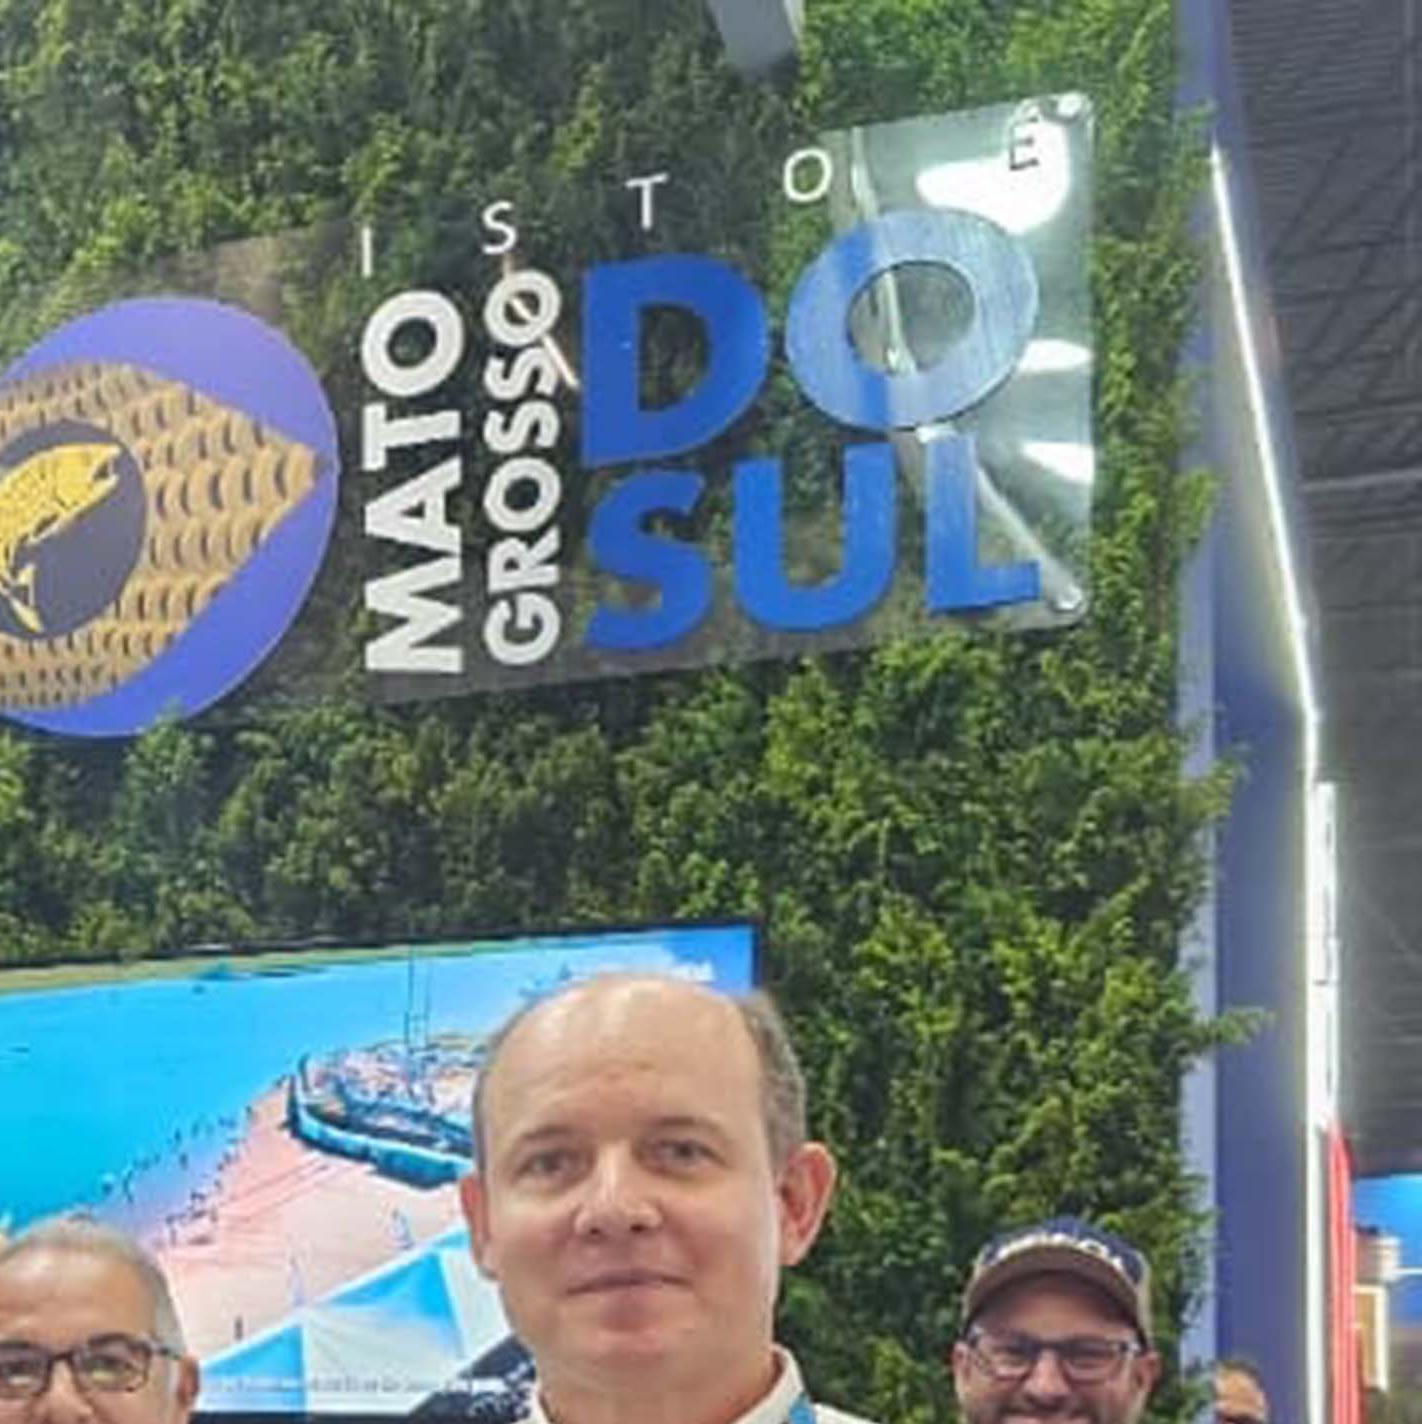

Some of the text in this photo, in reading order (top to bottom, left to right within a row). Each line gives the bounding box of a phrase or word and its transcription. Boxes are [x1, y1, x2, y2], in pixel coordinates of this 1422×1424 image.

[361, 288, 465, 674] MATO
[483, 268, 562, 667] GROSSO
[582, 208, 1040, 468] DO
[584, 433, 1042, 649] SUL
